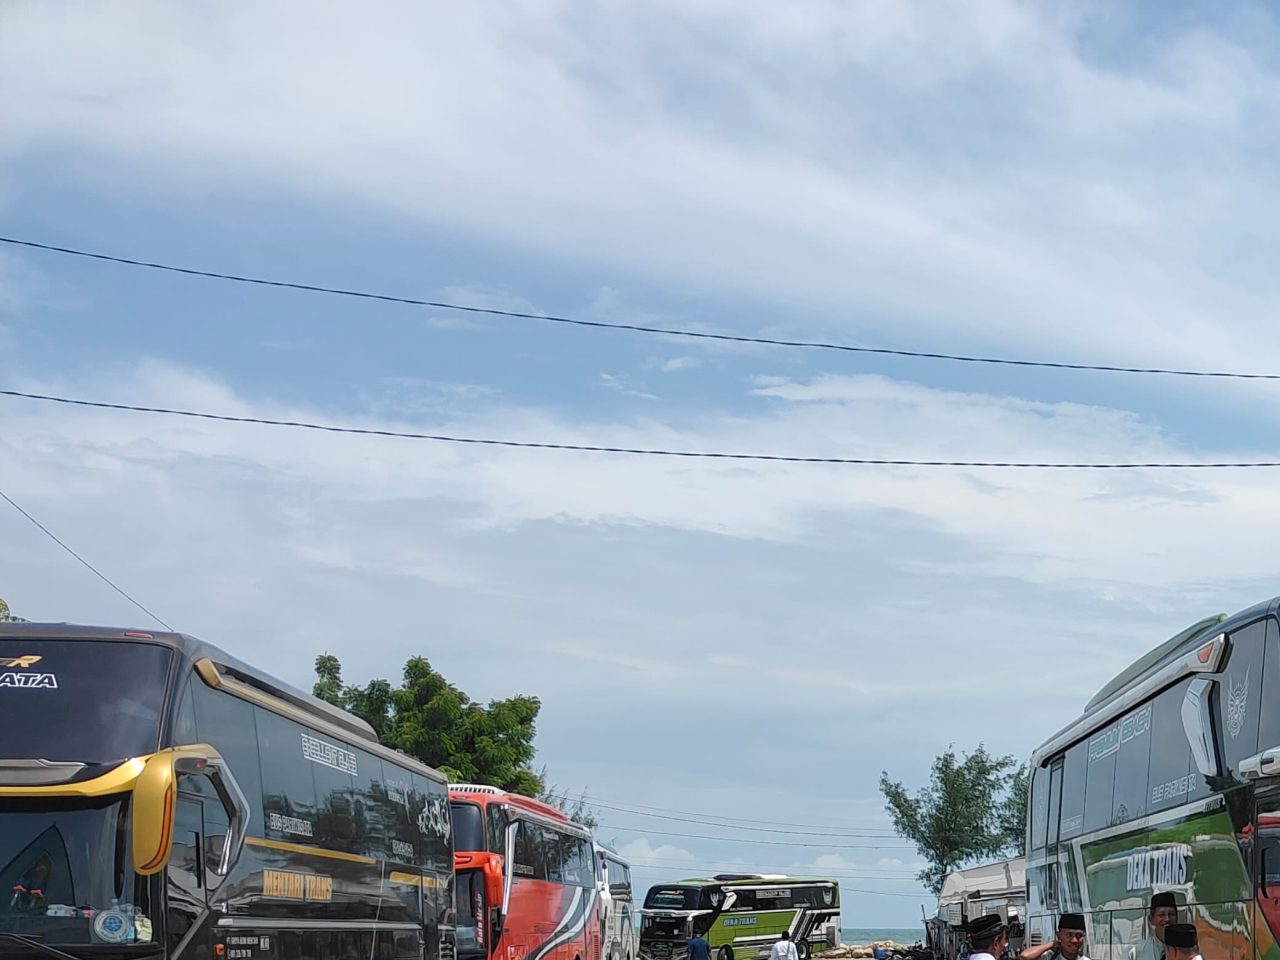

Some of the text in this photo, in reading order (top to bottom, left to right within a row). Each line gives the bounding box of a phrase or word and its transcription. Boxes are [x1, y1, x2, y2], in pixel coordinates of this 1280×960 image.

[0, 672, 58, 688] ATA
[263, 868, 332, 902] MENTARI TRANS
[1126, 848, 1187, 890] DEKA TRANS
